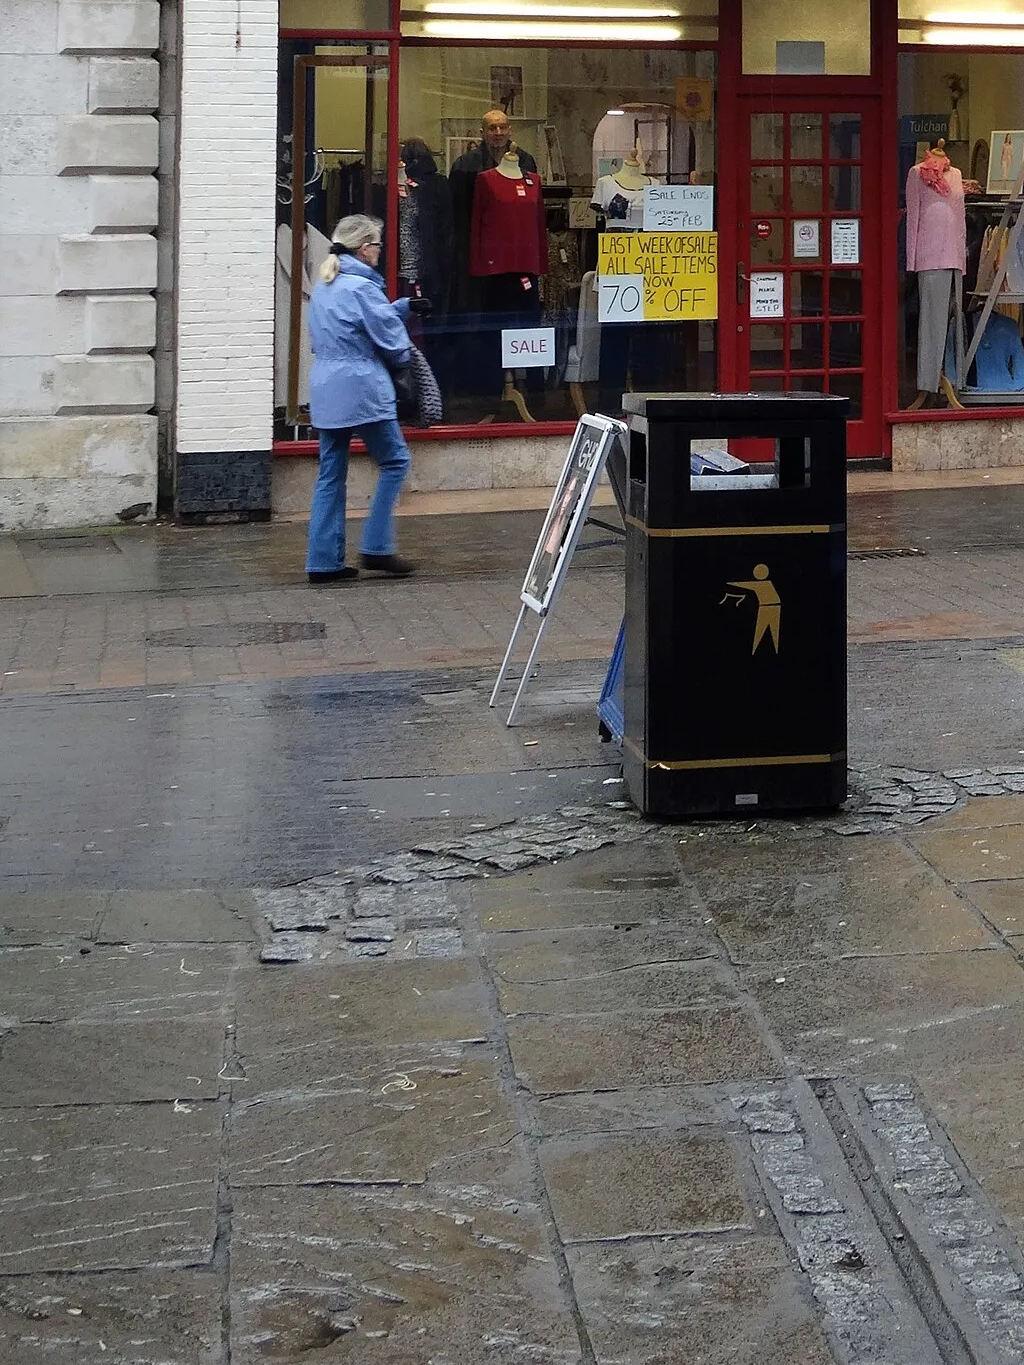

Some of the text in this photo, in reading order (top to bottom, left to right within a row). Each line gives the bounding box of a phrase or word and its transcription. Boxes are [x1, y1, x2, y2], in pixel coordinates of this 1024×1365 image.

[910, 119, 948, 132] Tulchan
[649, 189, 676, 201] SALE
[682, 215, 703, 227] FEB
[601, 236, 717, 254] LAST WEEK OF SALE
[605, 255, 716, 275] ALL SALE ITEMS
[643, 275, 674, 288] NOW
[664, 288, 707, 312] OFF
[755, 304, 780, 312] STEP
[510, 339, 548, 354] SALE
